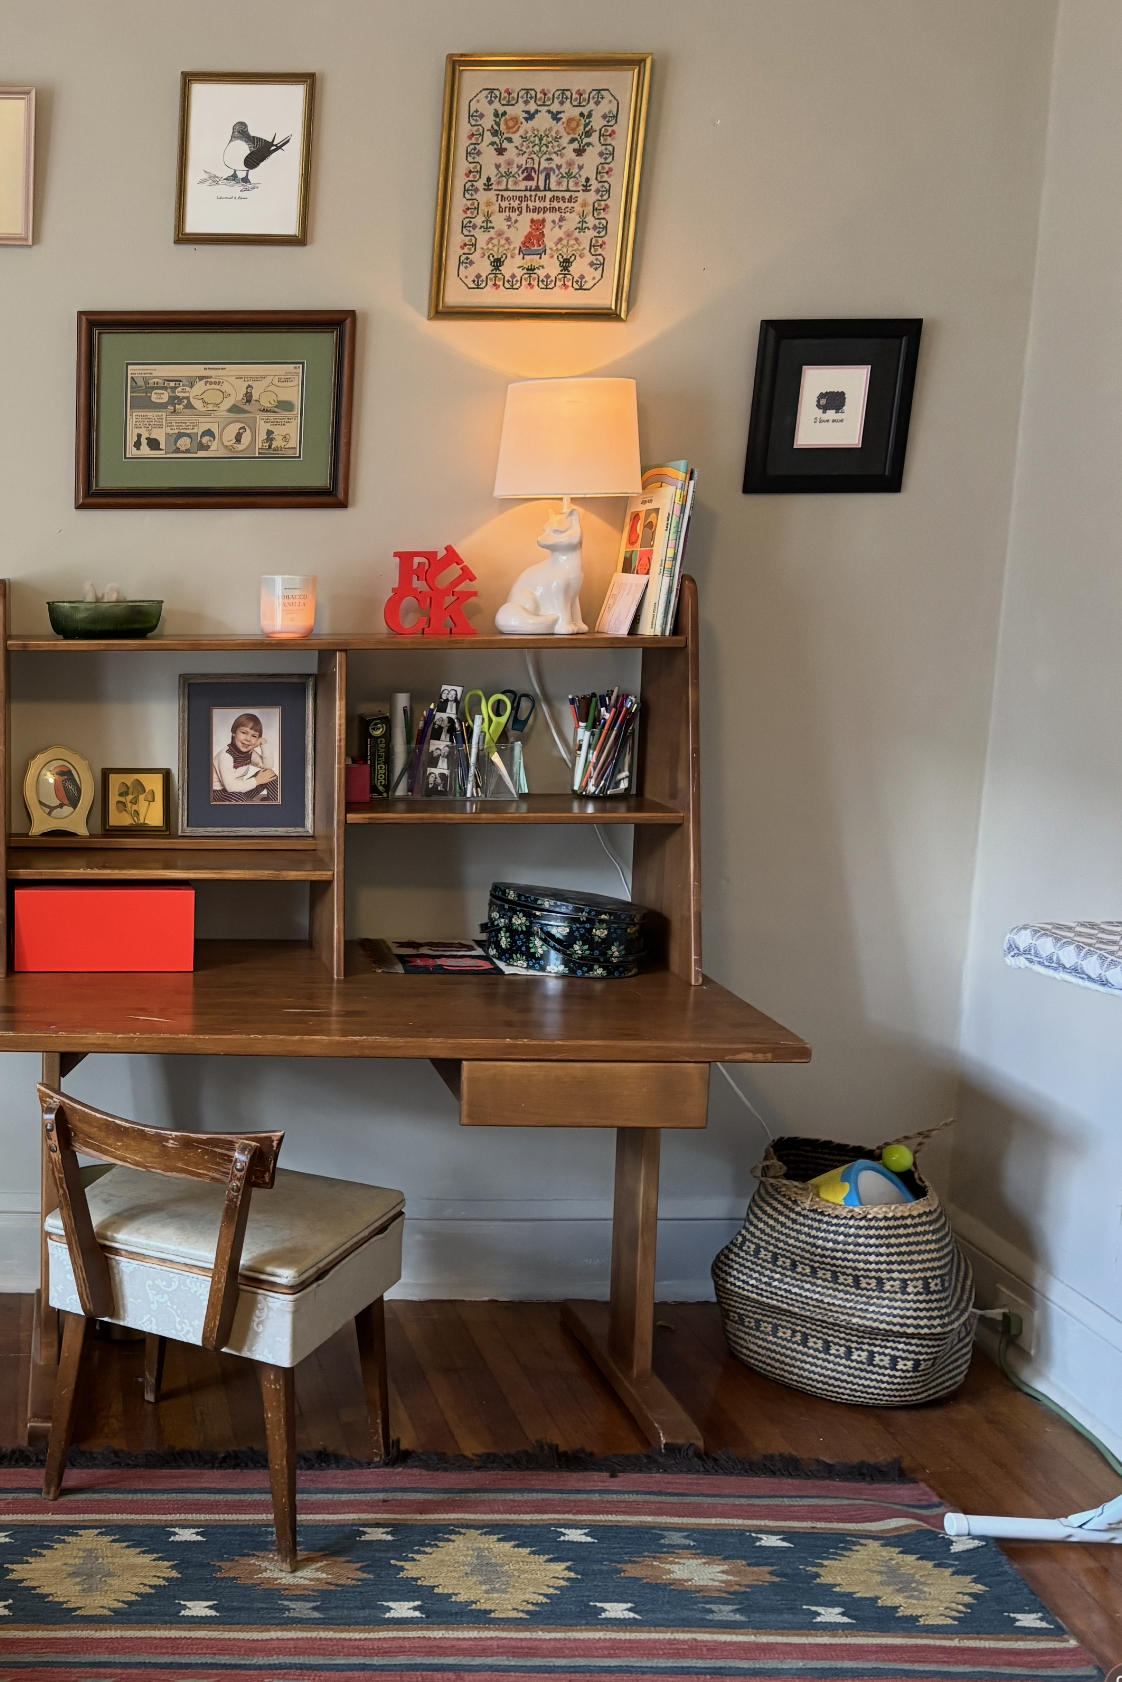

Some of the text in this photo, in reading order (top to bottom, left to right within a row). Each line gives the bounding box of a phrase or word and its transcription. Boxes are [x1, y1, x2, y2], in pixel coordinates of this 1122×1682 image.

[495, 193, 579, 205] Thoughtful deeds
[498, 203, 575, 216] bring happiness
